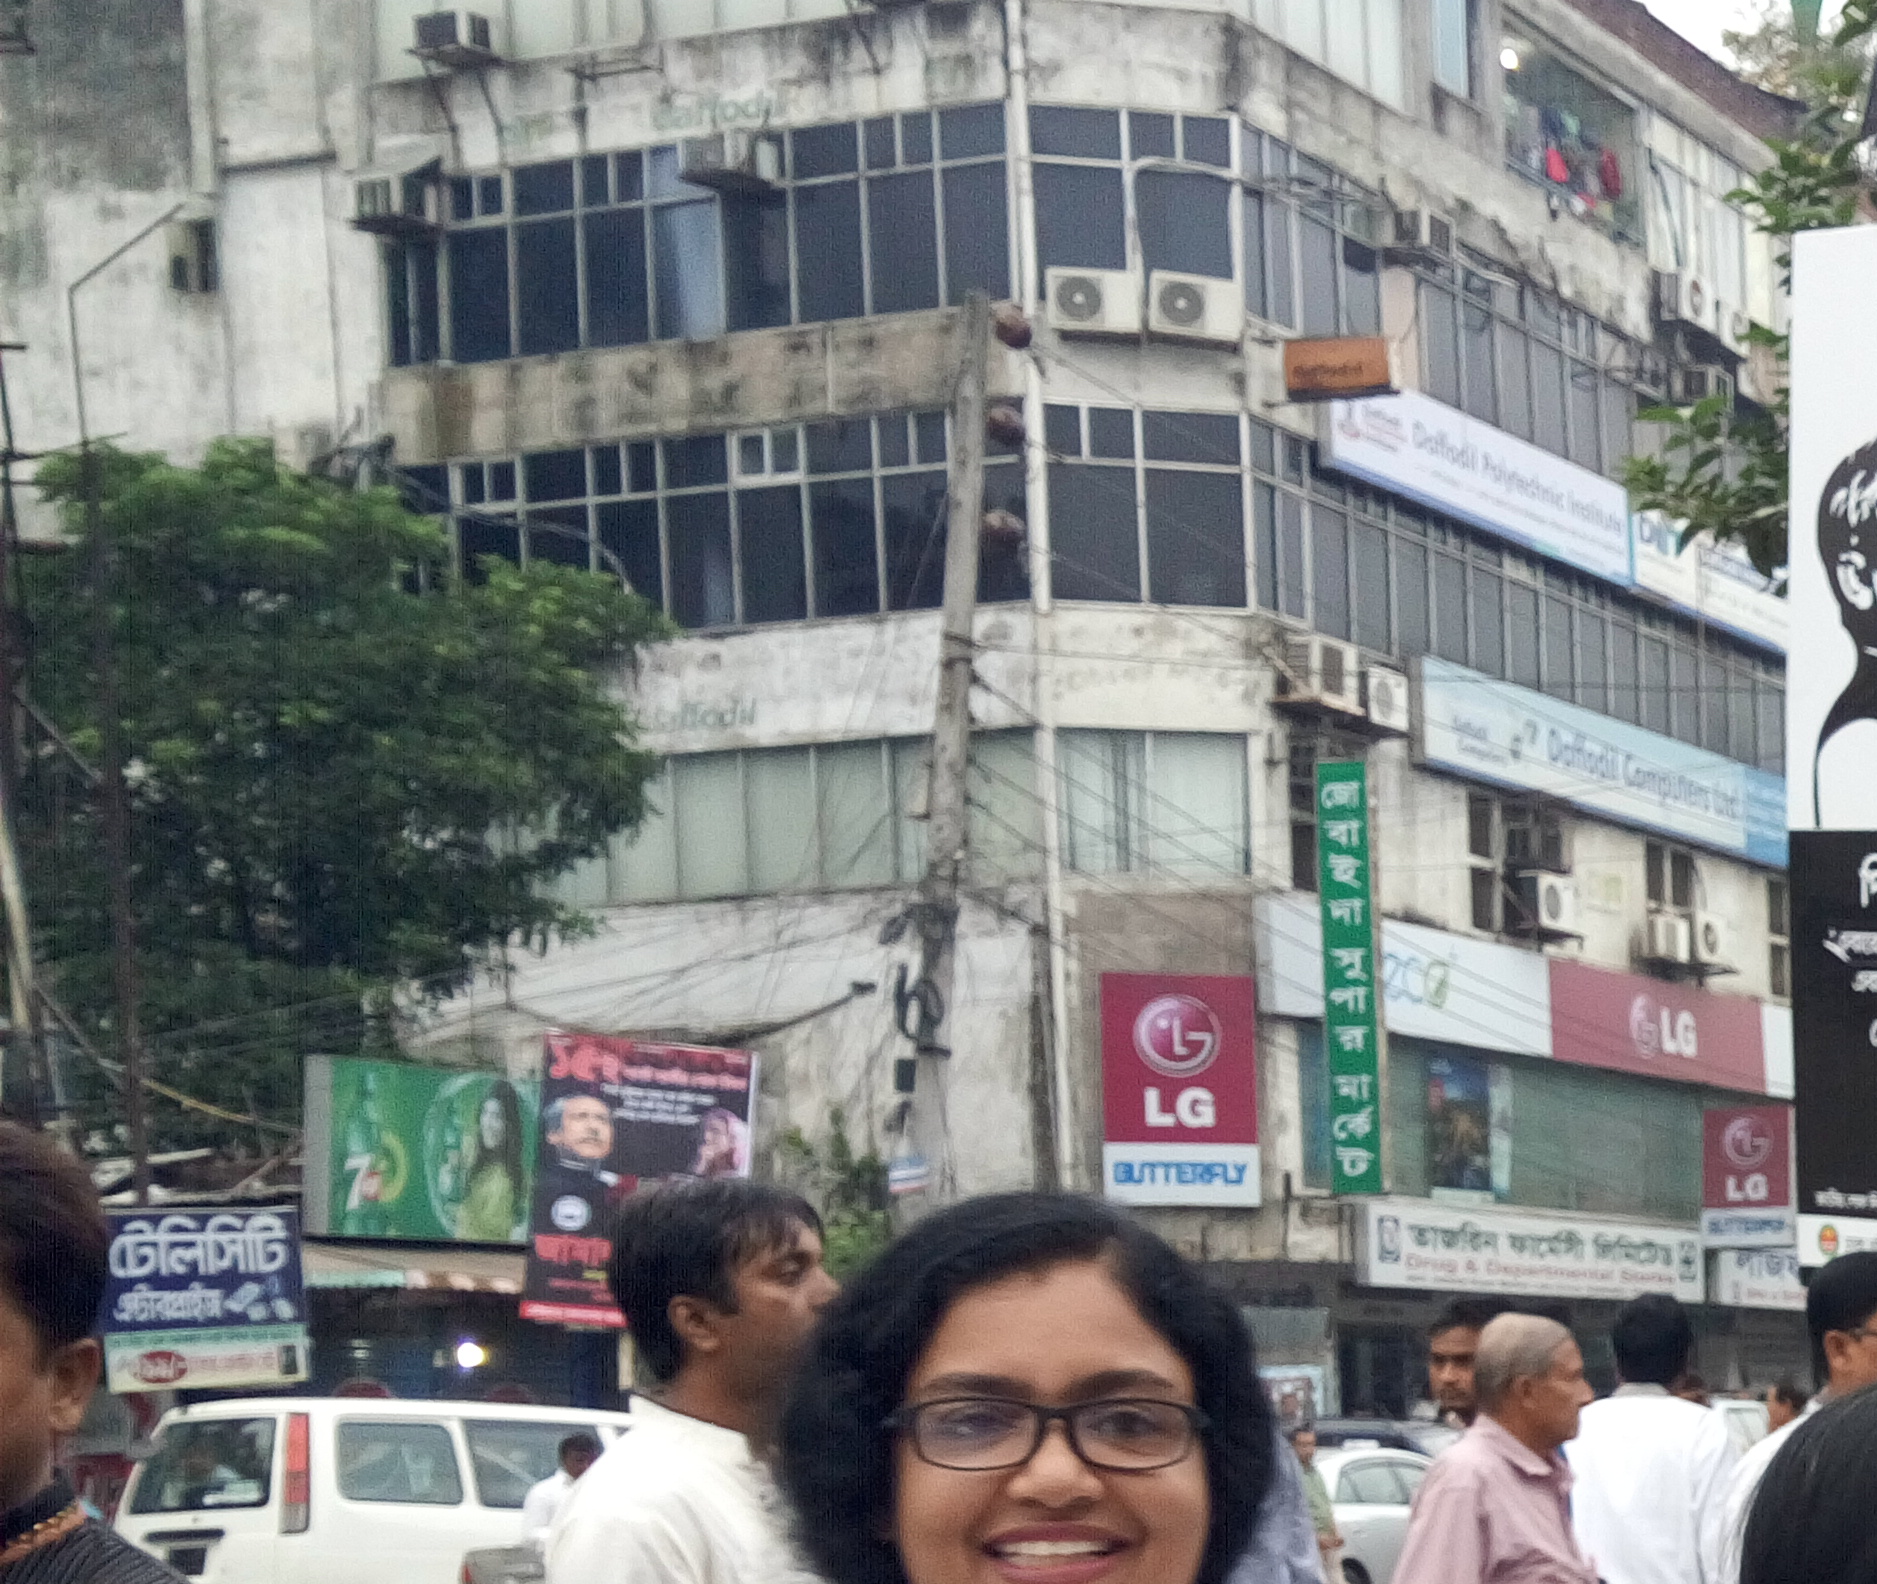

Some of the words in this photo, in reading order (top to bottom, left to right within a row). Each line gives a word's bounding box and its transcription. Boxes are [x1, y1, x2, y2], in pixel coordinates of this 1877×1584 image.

[1549, 727, 1622, 782] Daffodil
[1660, 1005, 1698, 1058] LG
[1143, 1085, 1217, 1129] LG
[1113, 1161, 1248, 1186] BUTTERFLY
[1725, 1172, 1769, 1201] LG
[109, 1214, 290, 1279] টেলিসিটি
